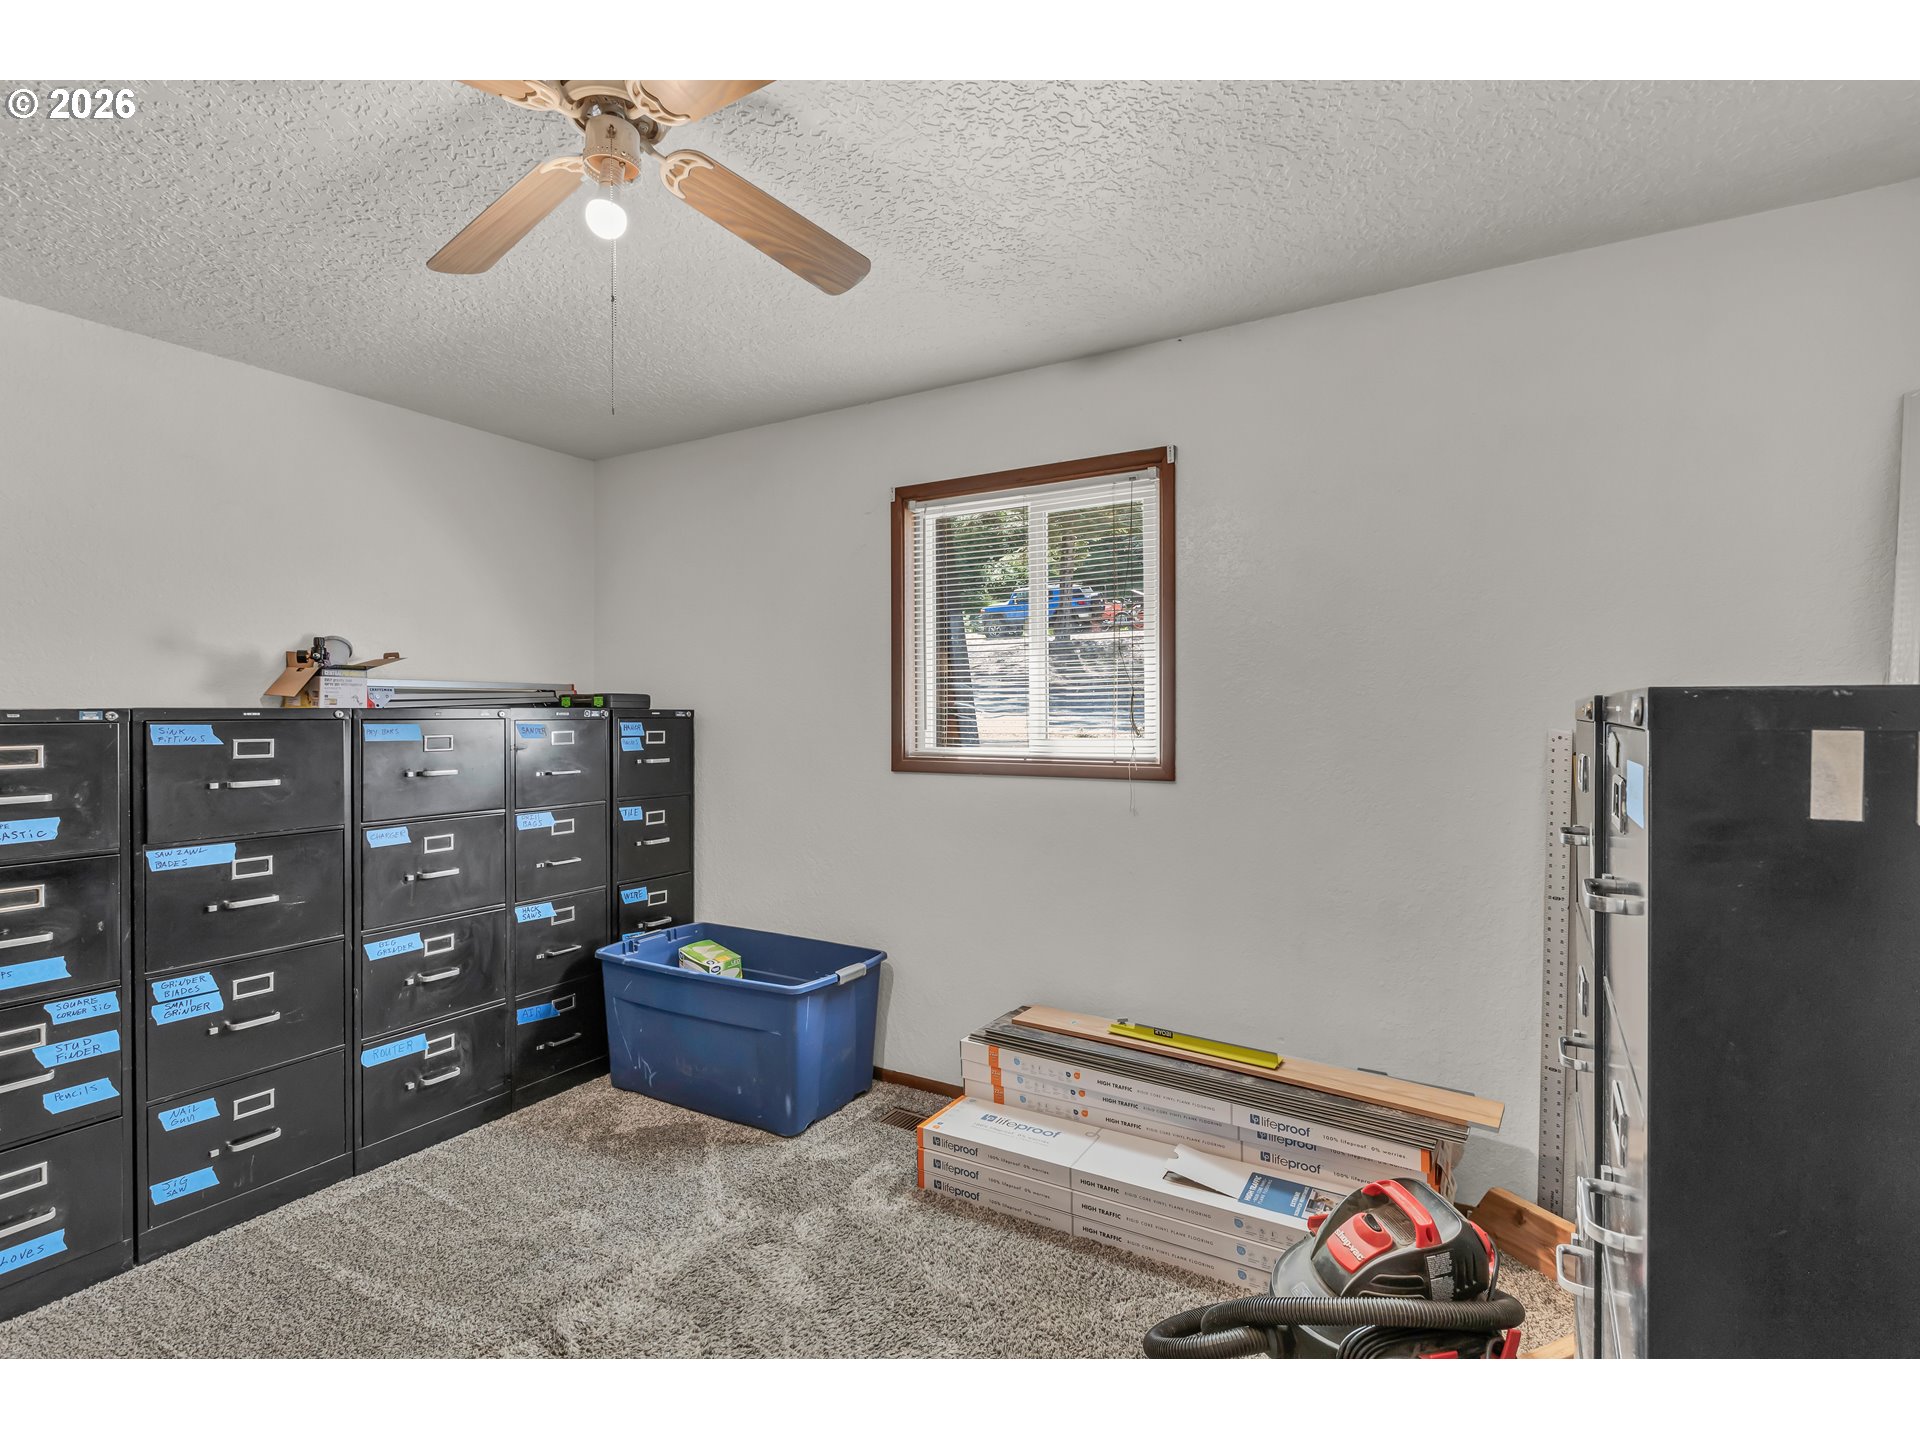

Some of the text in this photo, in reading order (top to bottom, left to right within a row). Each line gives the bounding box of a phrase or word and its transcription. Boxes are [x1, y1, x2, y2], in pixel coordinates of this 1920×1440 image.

[154, 850, 173, 858] SAW
[624, 890, 644, 900] WIRE
[376, 942, 414, 956] GRINDER
[378, 940, 397, 948] BIG
[56, 997, 98, 1011] SQUARE
[522, 1006, 542, 1018] AIR
[56, 1007, 87, 1020] CORNER
[1154, 1029, 1172, 1038] RYOBI
[56, 1038, 92, 1052] STUD
[372, 1040, 414, 1060] ROUTER
[54, 1084, 98, 1102] Pencils
[1112, 1082, 1132, 1092] TRAFFIC
[1176, 1098, 1190, 1106] PLANK
[1192, 1102, 1216, 1112] FLOORING
[1102, 1096, 1116, 1104] HIGH
[1118, 1100, 1138, 1110] TRAFFIC
[1199, 1118, 1222, 1127] FLOORING
[995, 1117, 1062, 1138] lifeproof
[1120, 1120, 1142, 1130] TRAFFIC
[1172, 1132, 1185, 1140] VINYL
[1202, 1140, 1226, 1148] FLOORING
[1261, 1116, 1310, 1138] lifeproof
[1322, 1134, 1338, 1142] 100%
[941, 1139, 978, 1156] lifeproof
[942, 1161, 979, 1180] lifeproof
[1272, 1154, 1320, 1174] lifeproof
[166, 1182, 187, 1198] SAW
[942, 1182, 980, 1201] lifeproof
[1080, 1178, 1096, 1188] HIGH
[1097, 1183, 1120, 1194] TRAFFIC
[1154, 1198, 1167, 1206] VINYL
[1168, 1204, 1184, 1212] PLANK
[1186, 1208, 1212, 1219] FLOORING
[1082, 1204, 1214, 1246] HIGH TRAFFIC RIGID CORE VINYL PLANK FLOORING
[1082, 1226, 1098, 1235] HIGH
[1099, 1231, 1122, 1242] TRAFFIC
[1142, 1244, 1154, 1252] CORE
[1156, 1248, 1170, 1256] VINYL
[1172, 1253, 1186, 1261] PLANK
[1188, 1258, 1214, 1270] FLOORING
